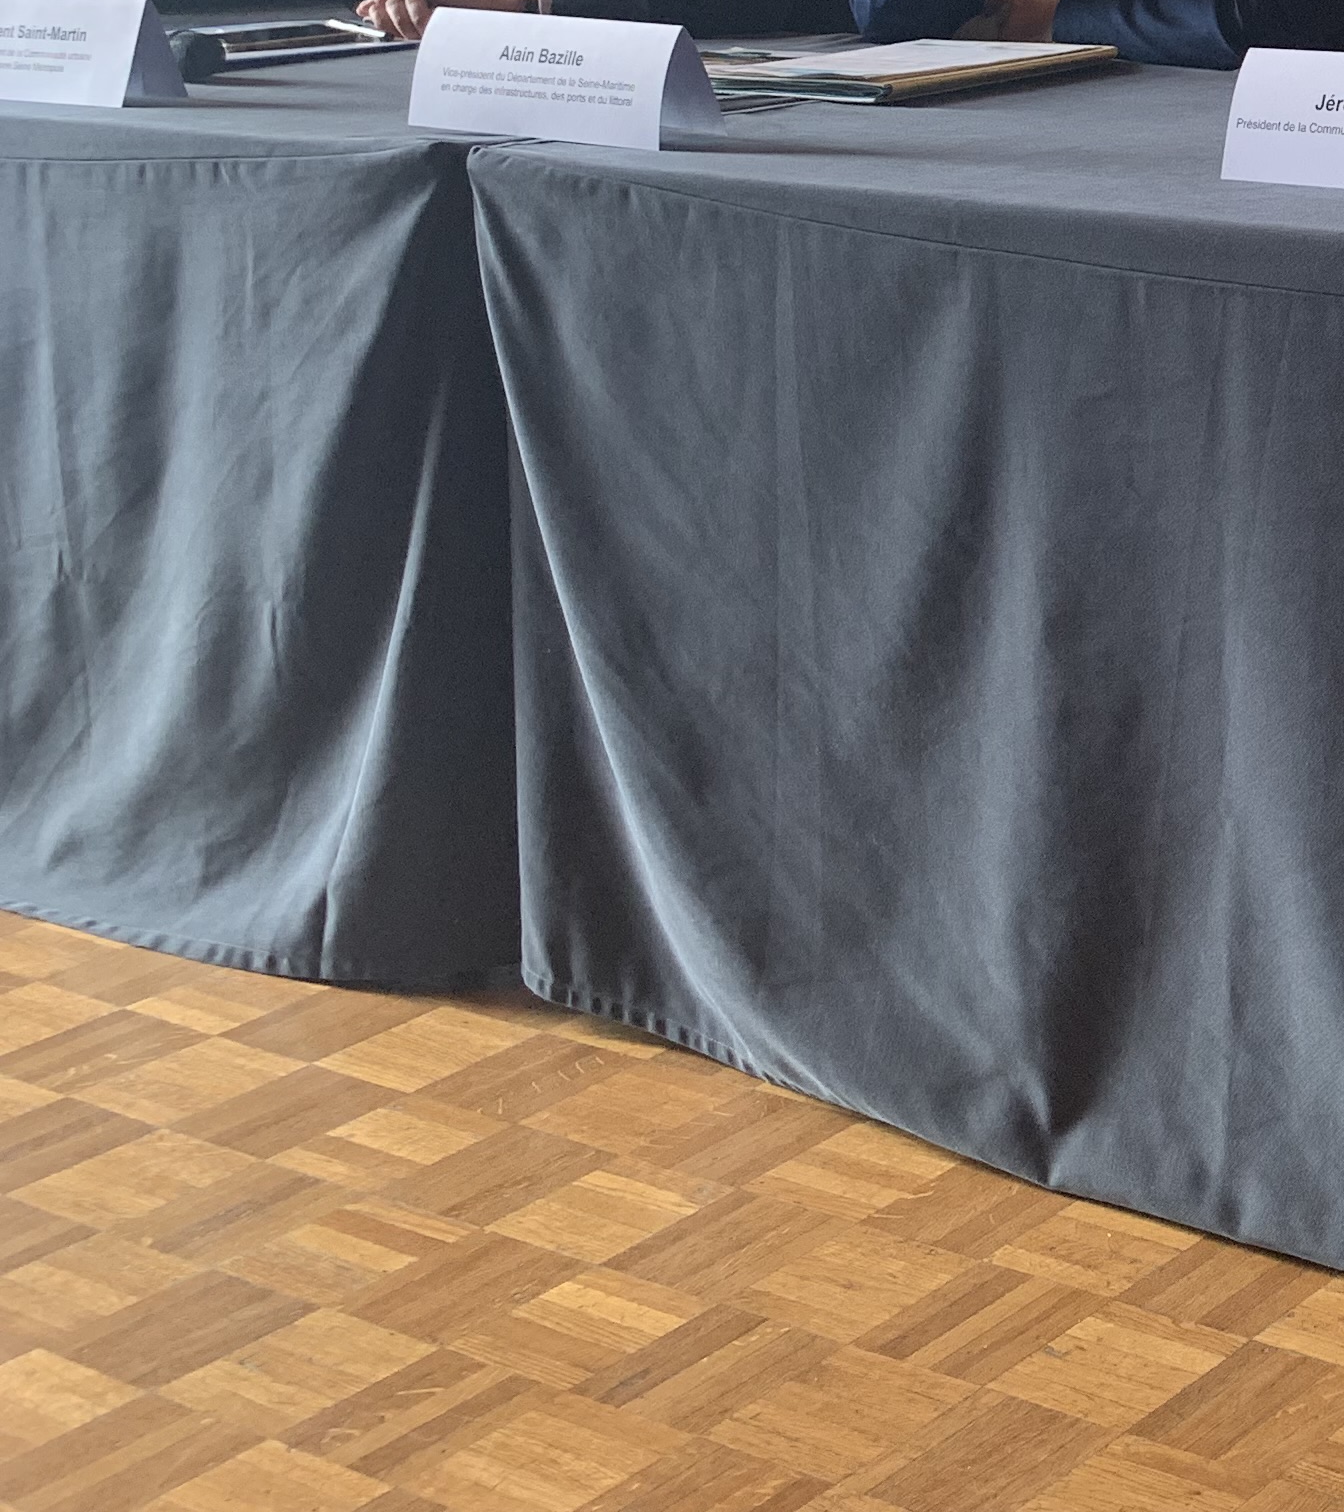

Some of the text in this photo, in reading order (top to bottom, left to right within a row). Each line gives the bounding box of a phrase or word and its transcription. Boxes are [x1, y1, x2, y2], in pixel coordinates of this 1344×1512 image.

[18, 25, 87, 42] Saint-Martin
[499, 45, 584, 66] Alain Bazille
[443, 67, 495, 81] Vice-président
[496, 72, 506, 82] du
[441, 84, 451, 92] en
[452, 83, 477, 96] charge
[479, 85, 493, 95] des
[551, 91, 565, 101] des
[567, 93, 586, 103] ports
[588, 95, 596, 103] et
[597, 95, 607, 104] du
[609, 95, 633, 107] littoral
[1236, 118, 1281, 132] Président
[1283, 121, 1295, 132] de
[1298, 122, 1306, 133] la
